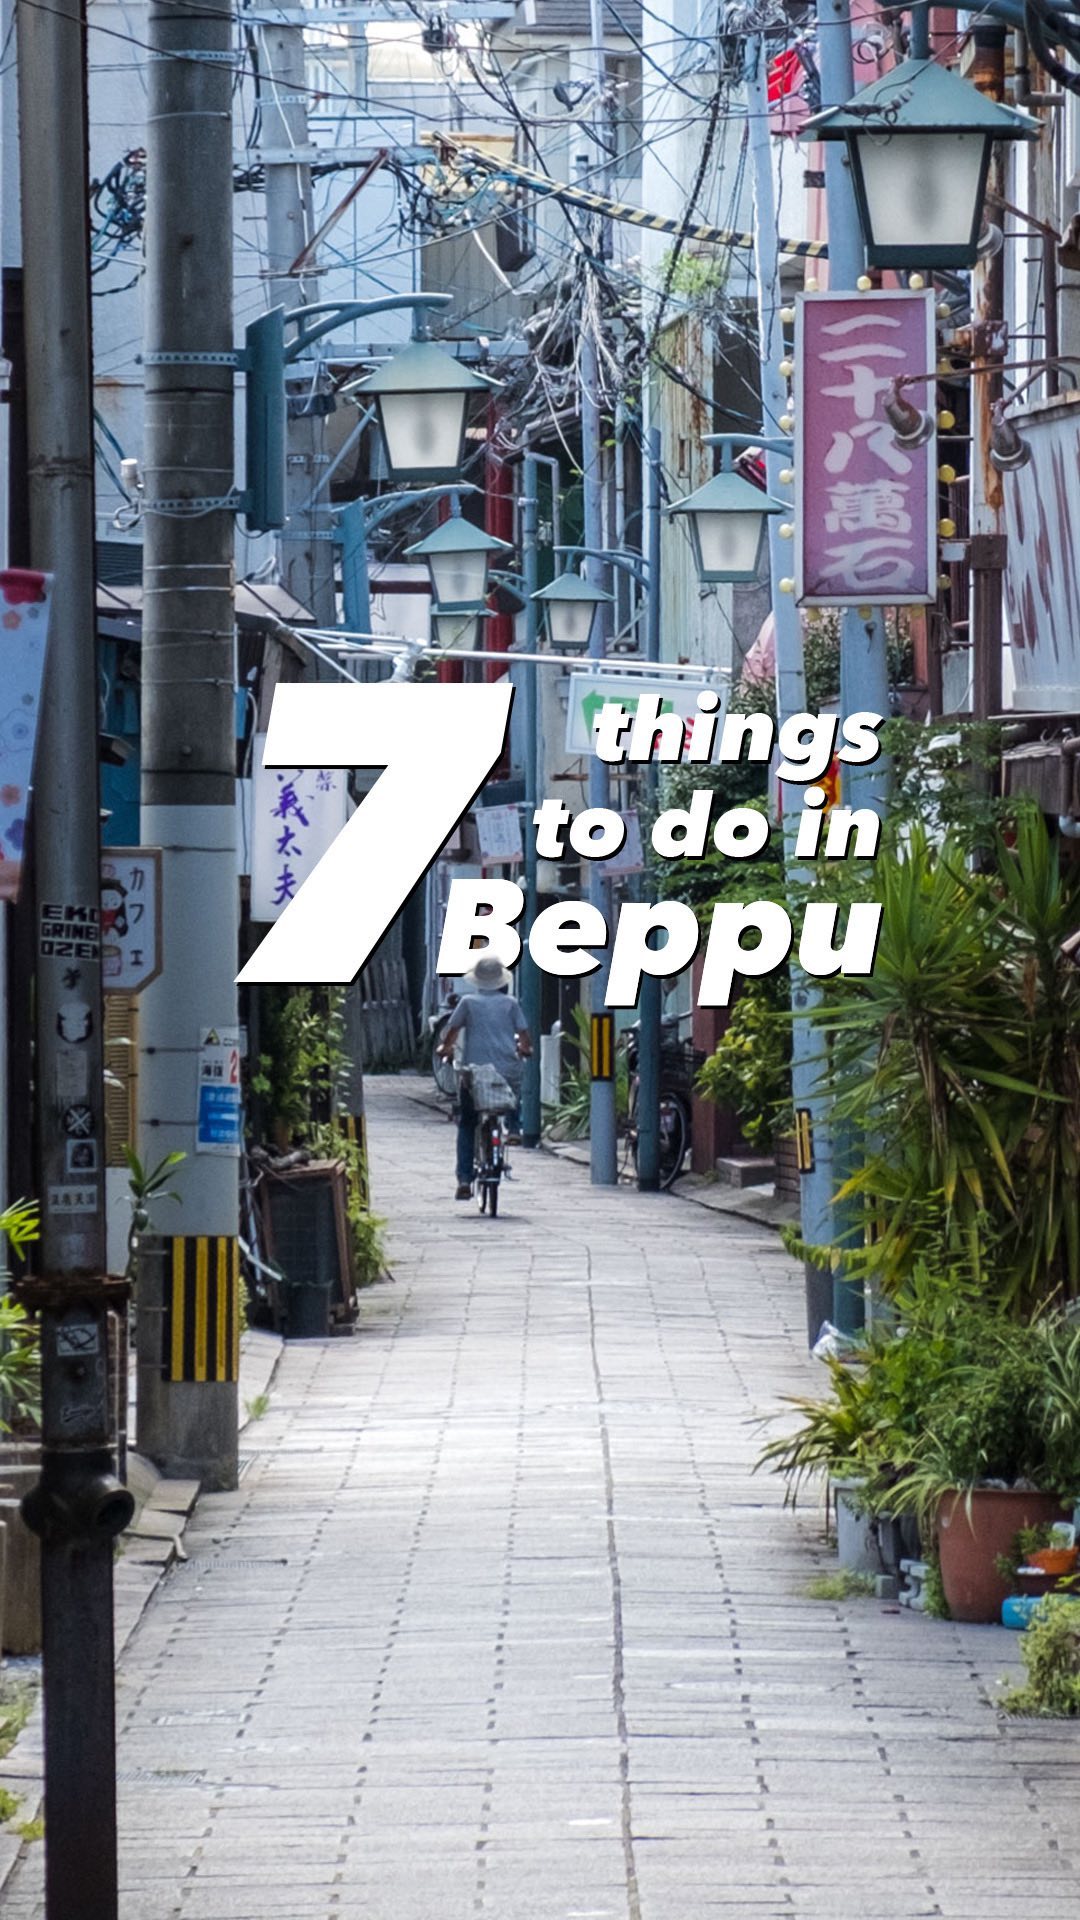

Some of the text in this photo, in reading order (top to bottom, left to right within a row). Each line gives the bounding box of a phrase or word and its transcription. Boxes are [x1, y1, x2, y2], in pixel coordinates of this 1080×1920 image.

[818, 313, 914, 591] 二十八萬石
